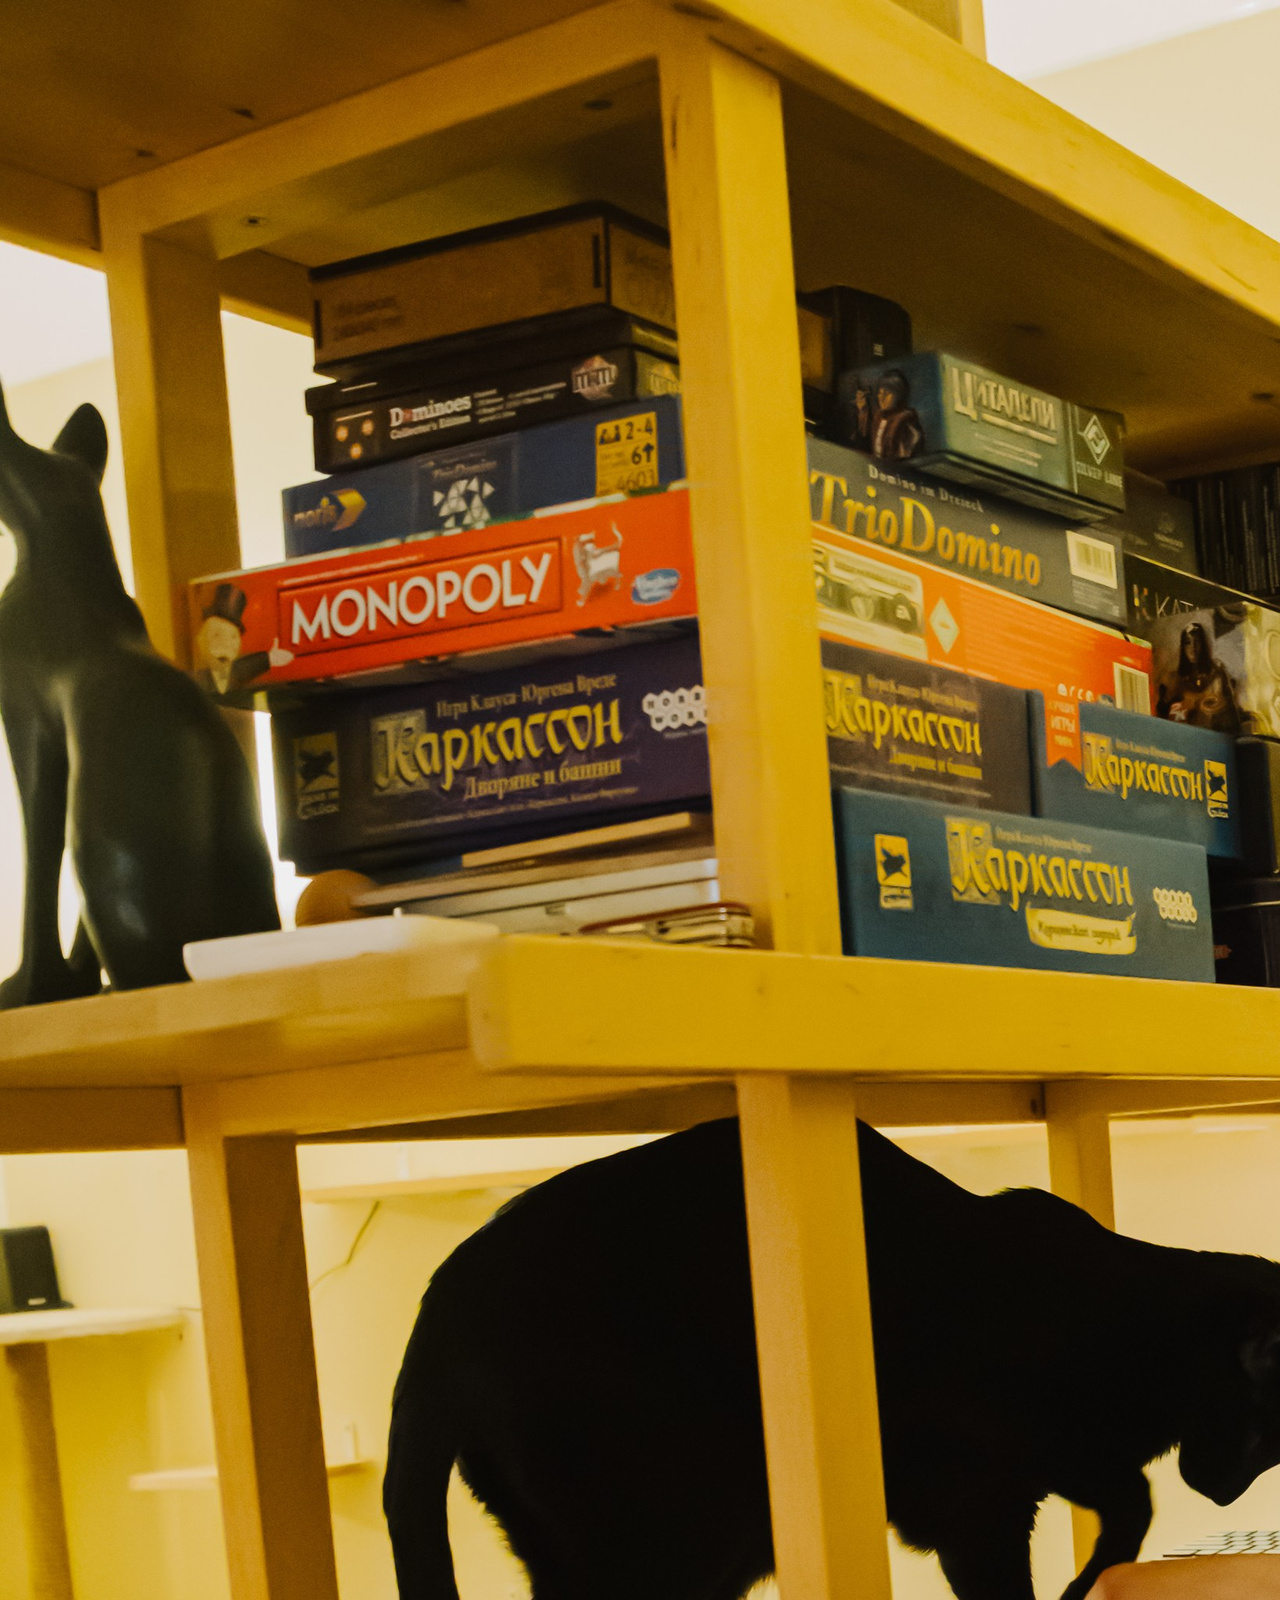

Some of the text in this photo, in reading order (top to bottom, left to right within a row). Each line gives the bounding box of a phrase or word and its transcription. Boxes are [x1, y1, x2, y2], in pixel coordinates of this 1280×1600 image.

[390, 396, 472, 427] Dominoes
[952, 367, 1057, 431] ЦИТАДЕЛИ
[631, 446, 642, 465] 6
[868, 464, 916, 492] Domino
[811, 470, 1041, 586] TrioDomino
[291, 553, 552, 645] MONOPOLY
[374, 698, 623, 792] Каркассон
[826, 675, 983, 757] Каркассон
[464, 758, 622, 801] Дворяне и башни
[1083, 733, 1204, 802] Каркассон
[951, 822, 1134, 913] Каркассон
